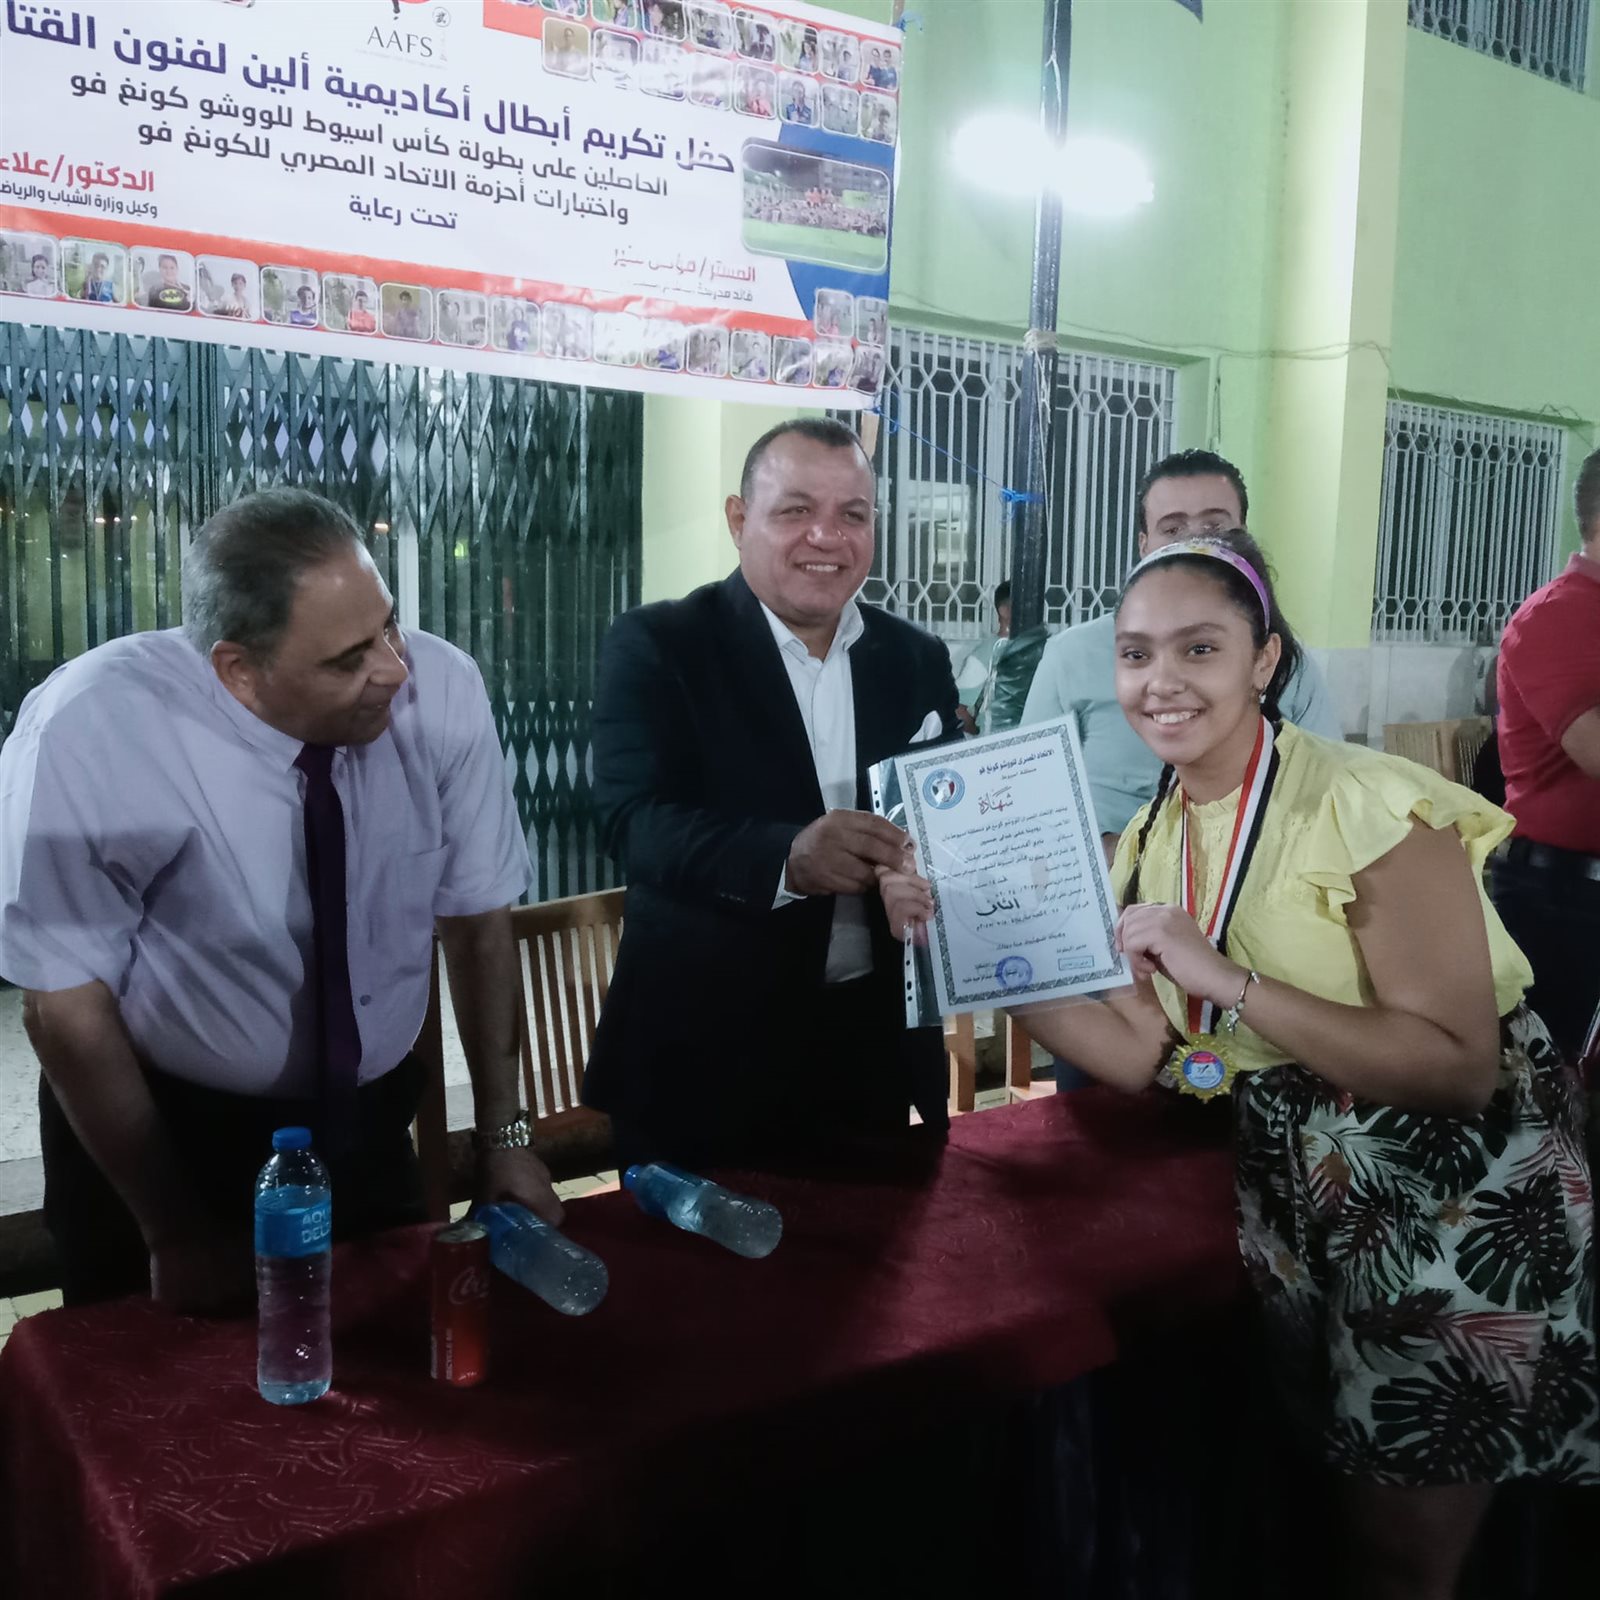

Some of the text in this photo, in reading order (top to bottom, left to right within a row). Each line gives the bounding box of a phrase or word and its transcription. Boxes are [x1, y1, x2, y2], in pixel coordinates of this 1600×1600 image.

[0, 0, 97, 50] القتا
[367, 25, 433, 58] AAFS
[113, 28, 226, 74] لفنون
[243, 51, 309, 95] ألين
[324, 65, 471, 122] أكاديمية
[70, 71, 667, 196] الحاصلين على بطولة كأس اسيوط للووشو كونغ فو
[484, 99, 570, 147] أبطال
[583, 127, 667, 160] تكريم
[138, 120, 628, 225] واختبارات أحزمة الاتحاد المصري للكونغ فو
[675, 137, 735, 173] حفل
[0, 180, 158, 219] وكيل وزارة الشباب والرياض
[349, 195, 458, 229] تحت رعاية
